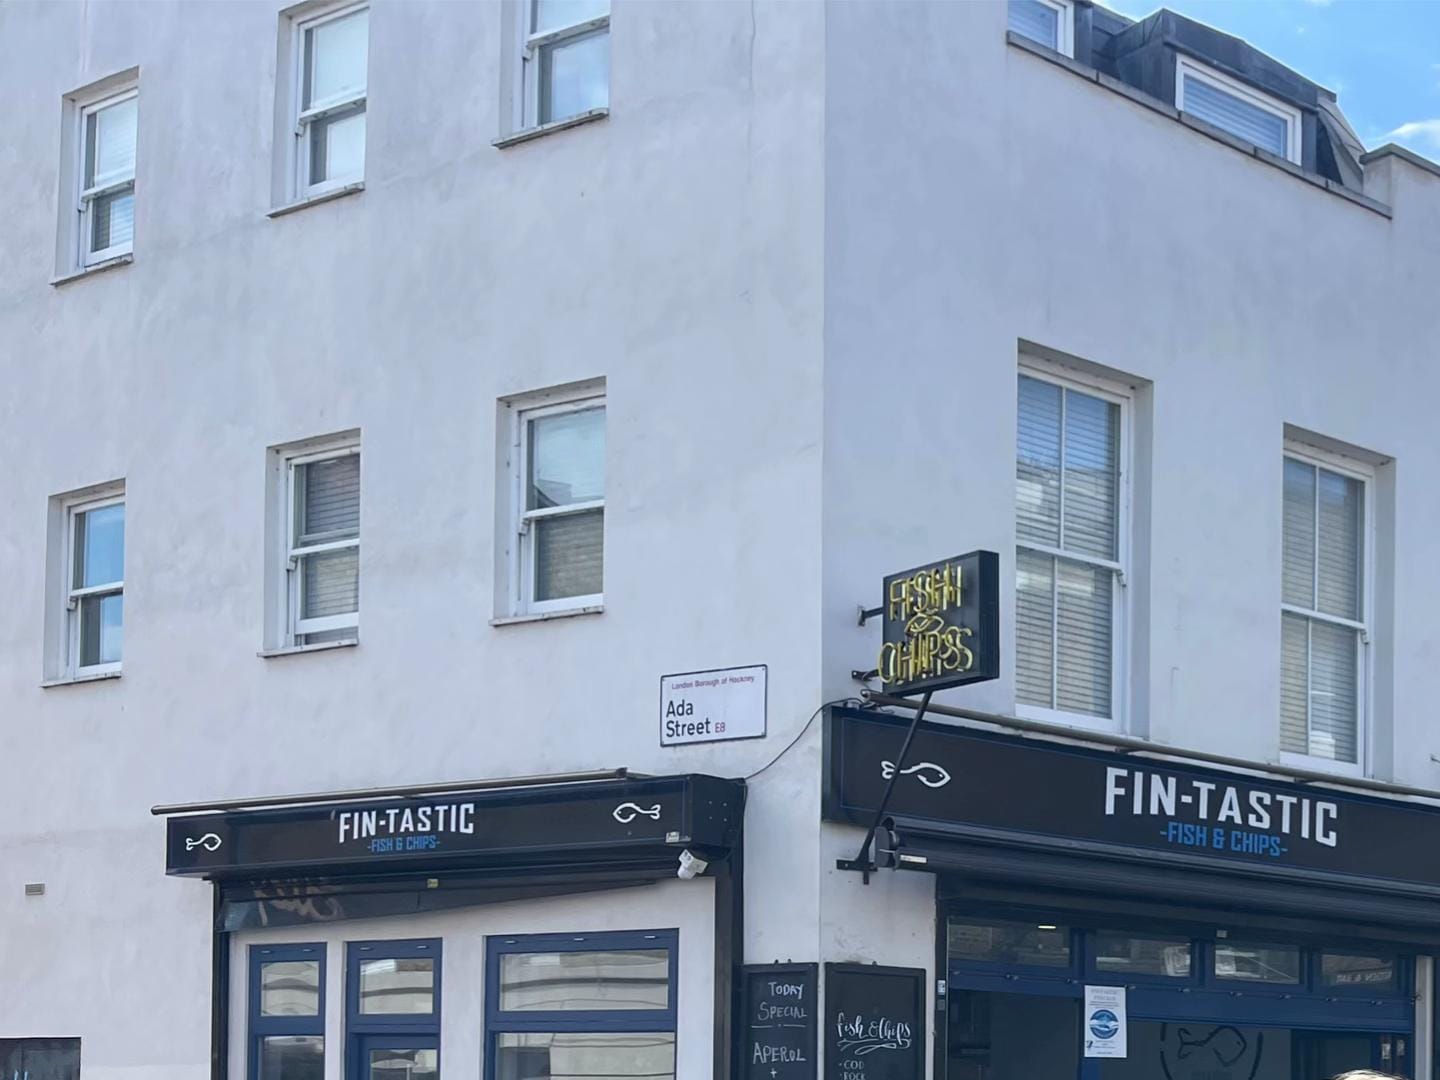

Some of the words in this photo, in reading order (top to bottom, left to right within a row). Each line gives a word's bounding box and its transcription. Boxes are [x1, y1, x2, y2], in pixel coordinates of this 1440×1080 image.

[666, 699, 694, 718] Ada
[666, 717, 711, 738] Street
[714, 722, 726, 733] E8
[1105, 766, 1337, 848] FIN-TASTIC
[339, 803, 475, 843] FIN-TASTIC
[396, 837, 403, 851] &
[1212, 828, 1225, 849] &
[768, 981, 804, 1000] TODAY
[757, 1001, 808, 1021] SPECIAL
[752, 1041, 807, 1065] APEROL
